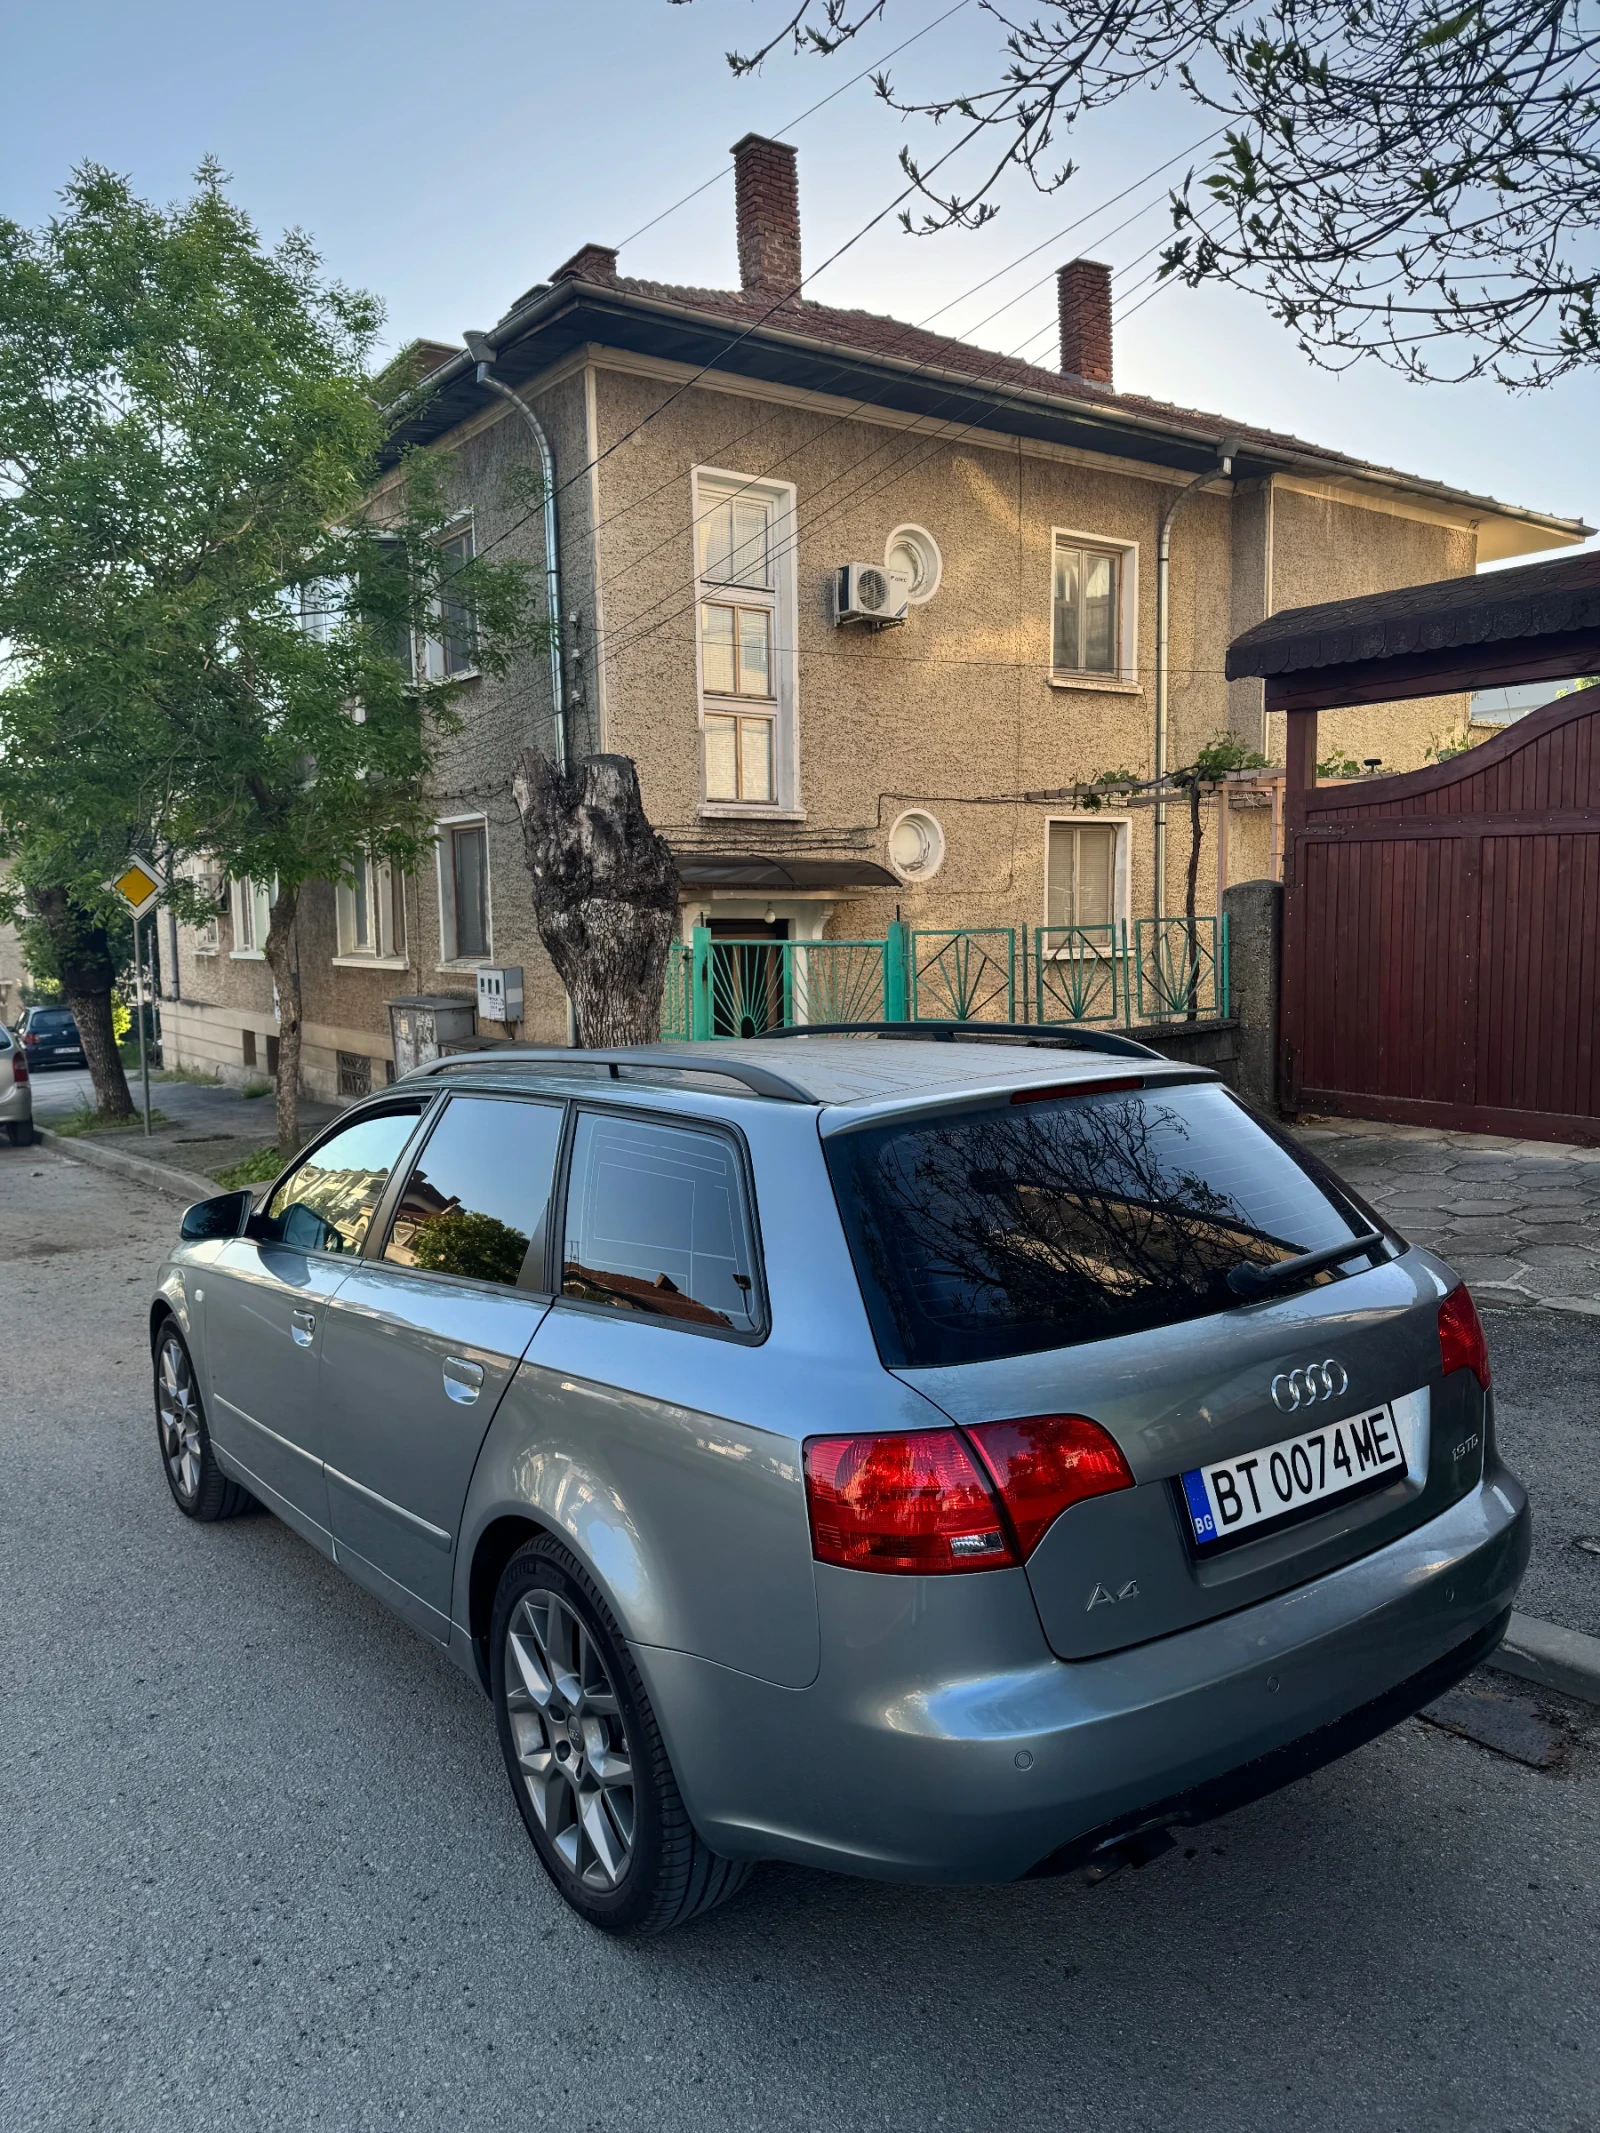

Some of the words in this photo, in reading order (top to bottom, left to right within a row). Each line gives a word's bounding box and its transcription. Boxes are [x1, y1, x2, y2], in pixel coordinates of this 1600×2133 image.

[1210, 1458, 1262, 1525] BT
[1269, 1428, 1353, 1502] 0074
[1349, 1411, 1396, 1472] ME
[1194, 1514, 1214, 1534] BG
[1085, 1579, 1140, 1612] A4
